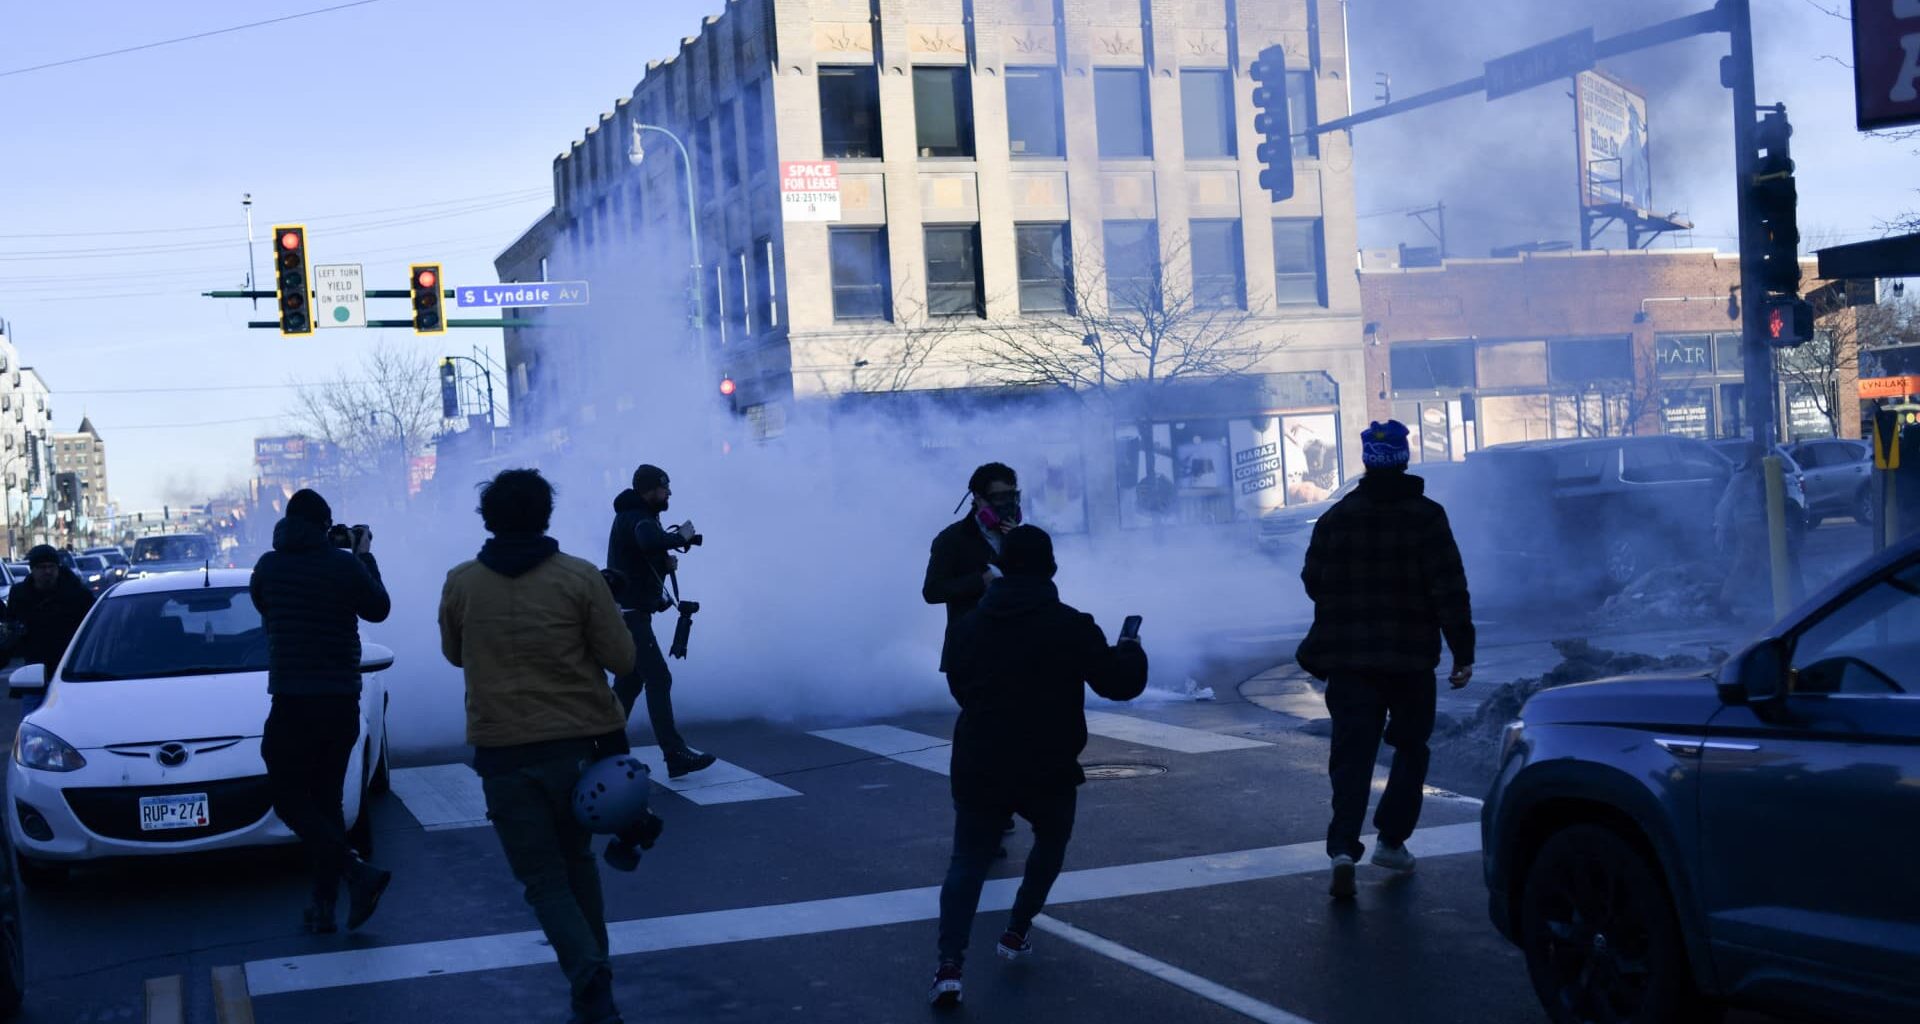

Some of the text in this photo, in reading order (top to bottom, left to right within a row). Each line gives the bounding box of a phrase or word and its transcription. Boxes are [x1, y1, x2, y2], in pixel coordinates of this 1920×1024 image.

[1591, 127, 1609, 154] Blue
[788, 164, 832, 177] SPACE
[784, 177, 837, 190] FOR LEASE
[318, 267, 359, 278] LEFT TURN
[327, 280, 352, 291] YIELD
[321, 293, 359, 304] ON GREEN
[464, 288, 580, 305] S Lyndale Av
[1656, 347, 1705, 364] HAIR
[1238, 444, 1275, 463] HARAZ
[1236, 459, 1279, 478] COMING
[1244, 476, 1274, 492] SOON
[143, 802, 205, 823] RUP 274
